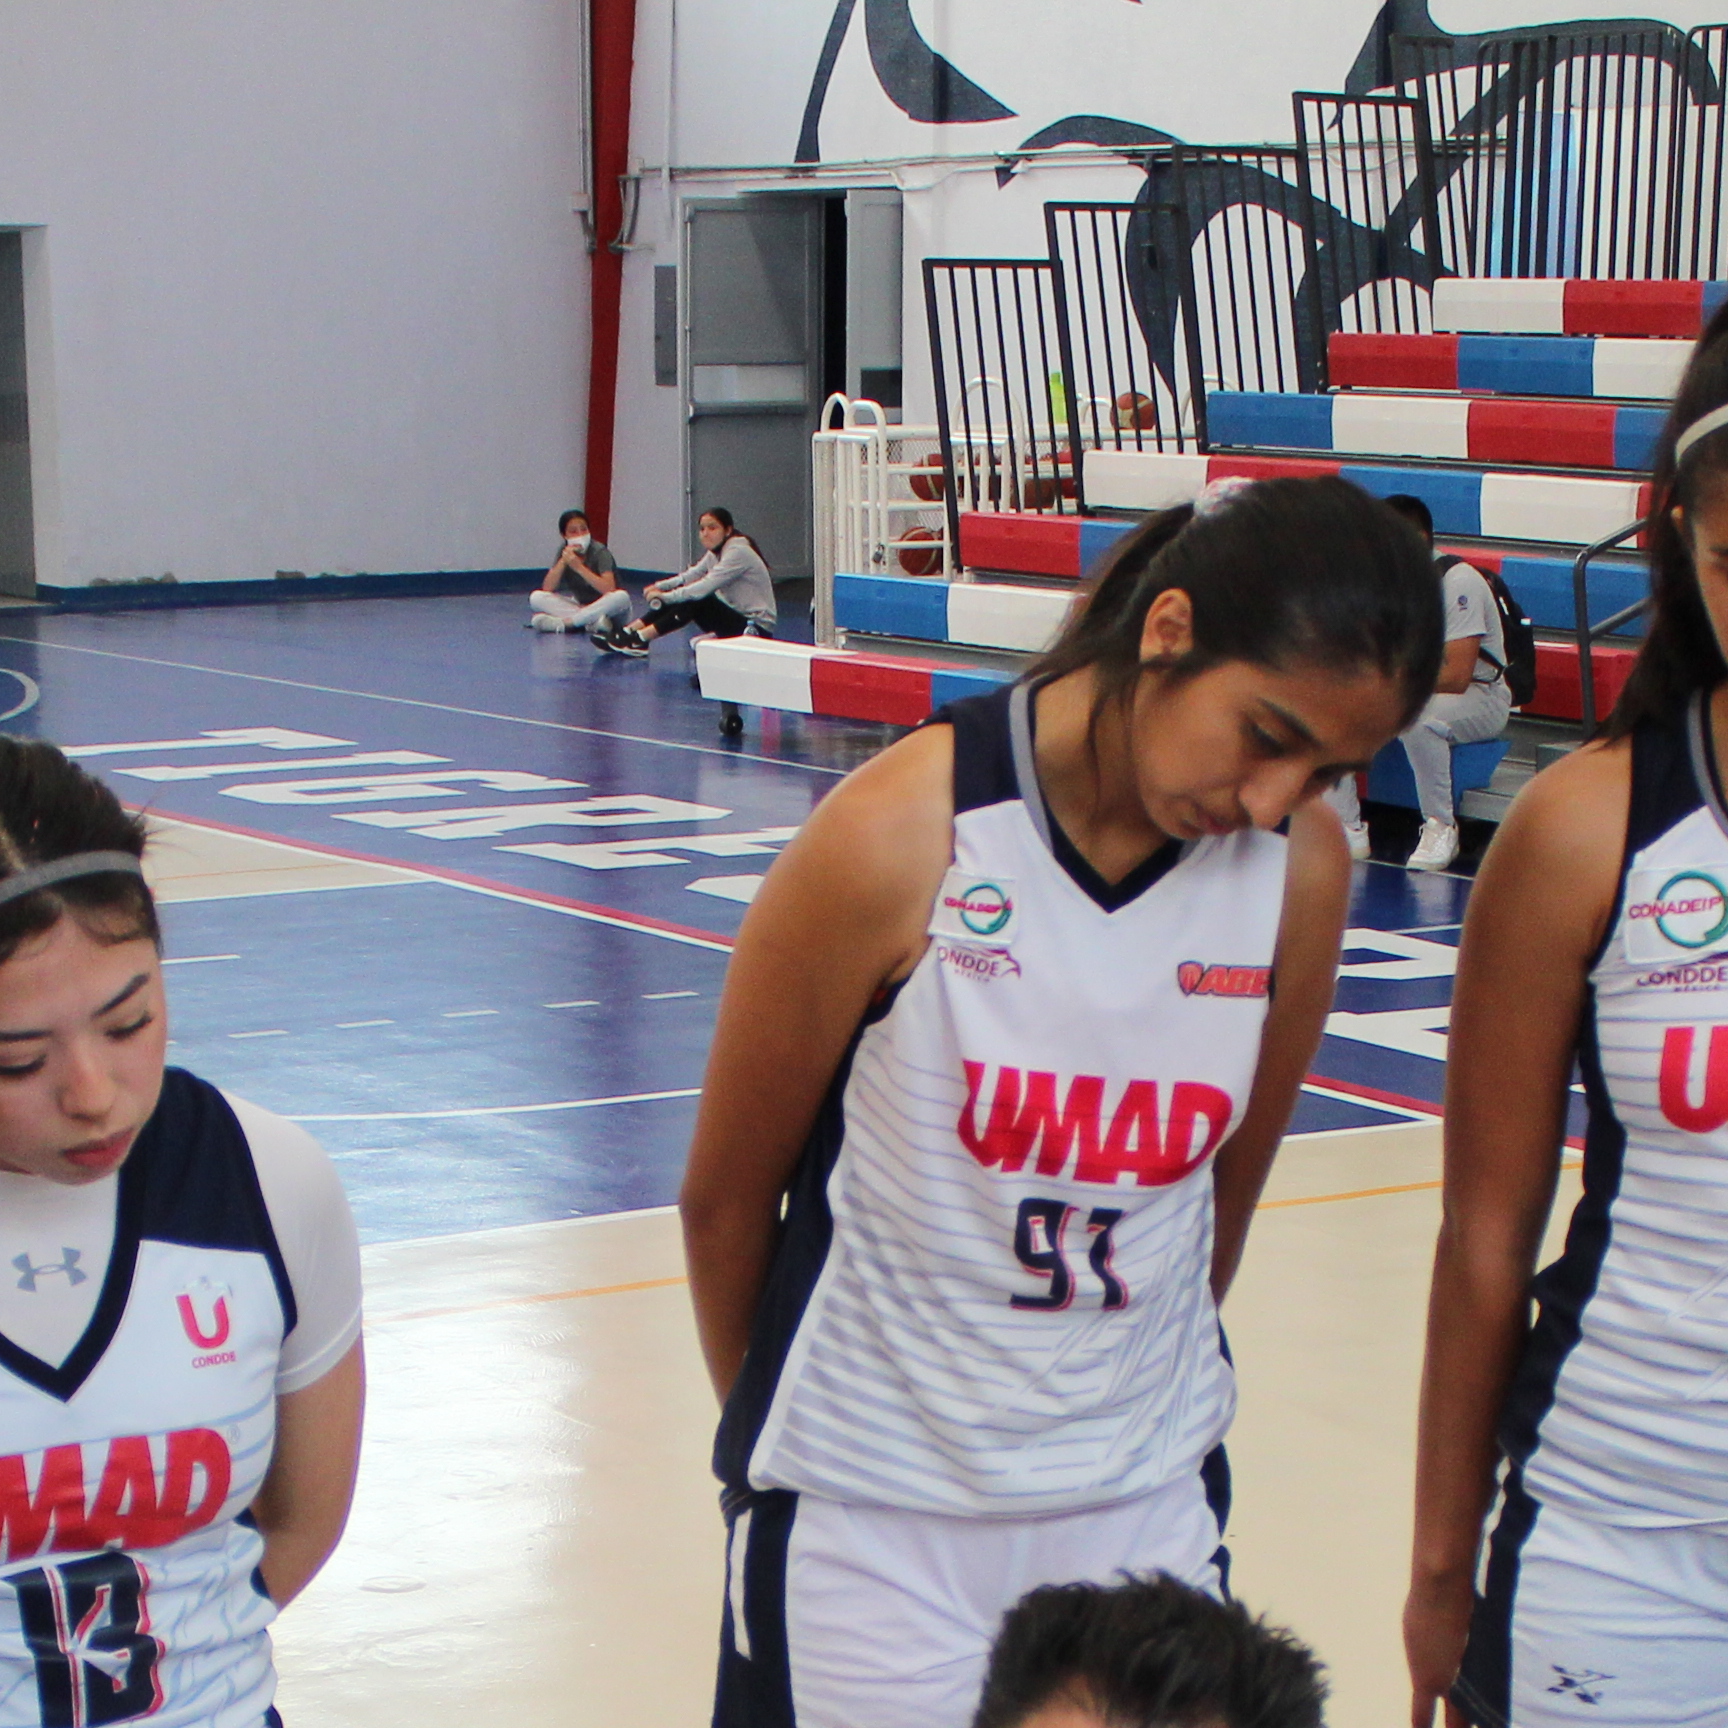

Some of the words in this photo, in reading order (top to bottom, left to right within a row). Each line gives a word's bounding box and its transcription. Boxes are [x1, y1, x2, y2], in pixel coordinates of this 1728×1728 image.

[62, 725, 804, 905] TIGRE
[937, 946, 999, 976] ONDDE
[957, 1059, 1233, 1188] UMAD
[1010, 1197, 1130, 1312] 91
